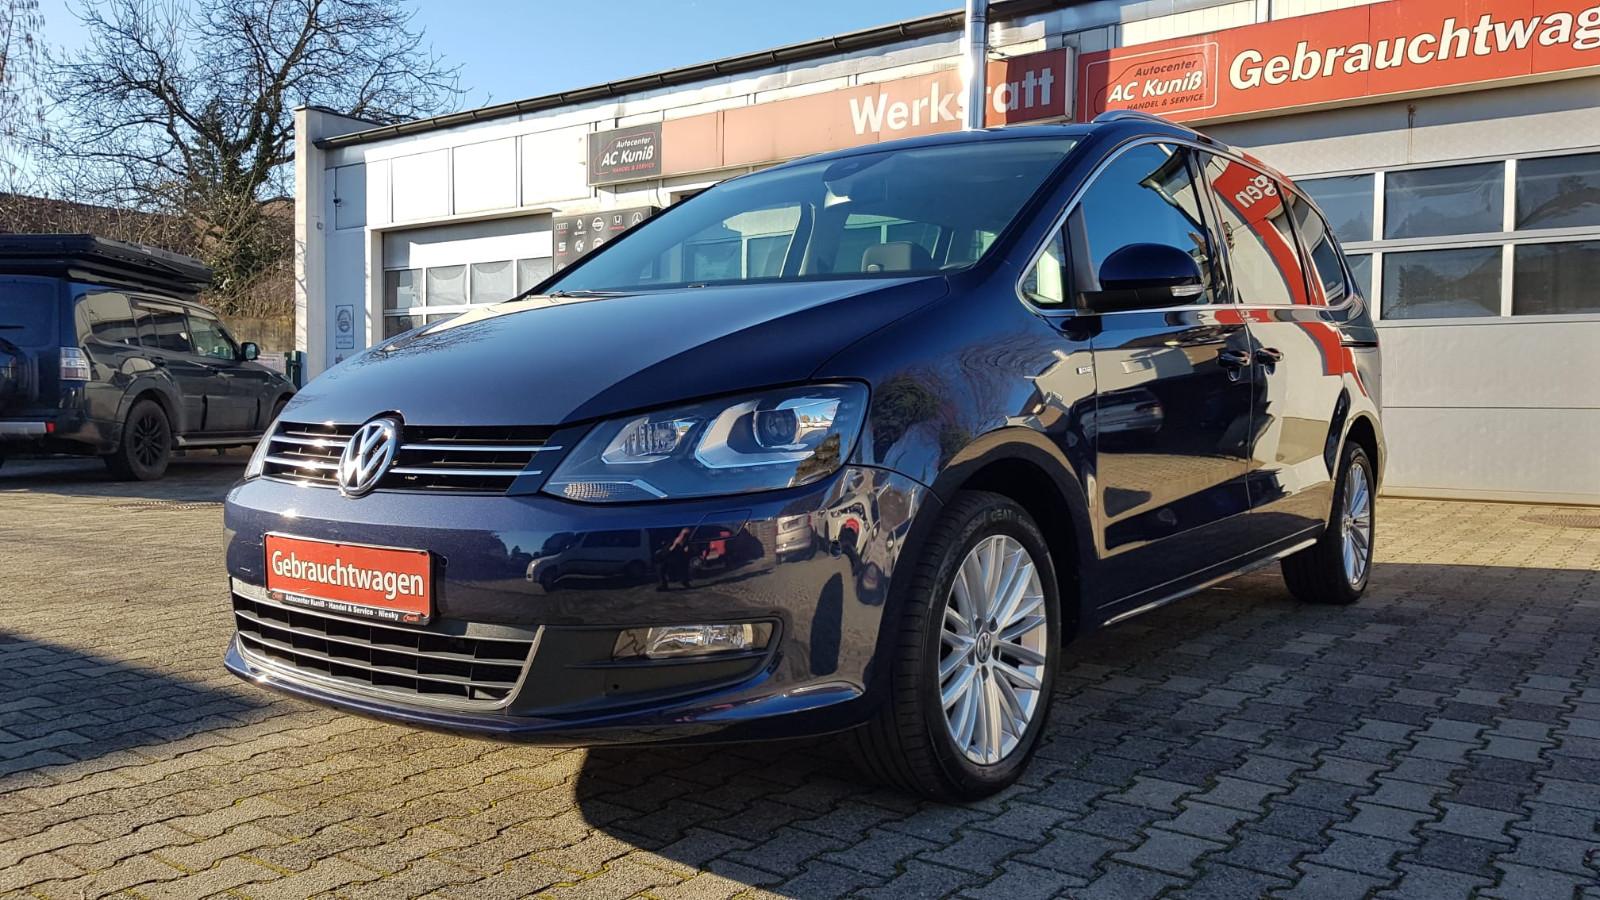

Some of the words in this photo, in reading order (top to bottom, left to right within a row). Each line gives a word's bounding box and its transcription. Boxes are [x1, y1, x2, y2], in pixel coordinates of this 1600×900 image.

[1134, 60, 1198, 77] Autocenter
[1107, 81, 1139, 103] AC
[1142, 70, 1203, 98] Kuniß
[849, 67, 1054, 135] Werkatt
[1127, 100, 1159, 111] HANDEL
[1161, 98, 1168, 106] &
[1170, 93, 1205, 105] SERVICE
[616, 136, 651, 149] Autocenter
[601, 151, 619, 167] AC
[621, 145, 654, 163] Kuniß
[271, 550, 425, 600] Gebrauchtwagen
[329, 602, 347, 611] Handel
[353, 605, 374, 616] Service
